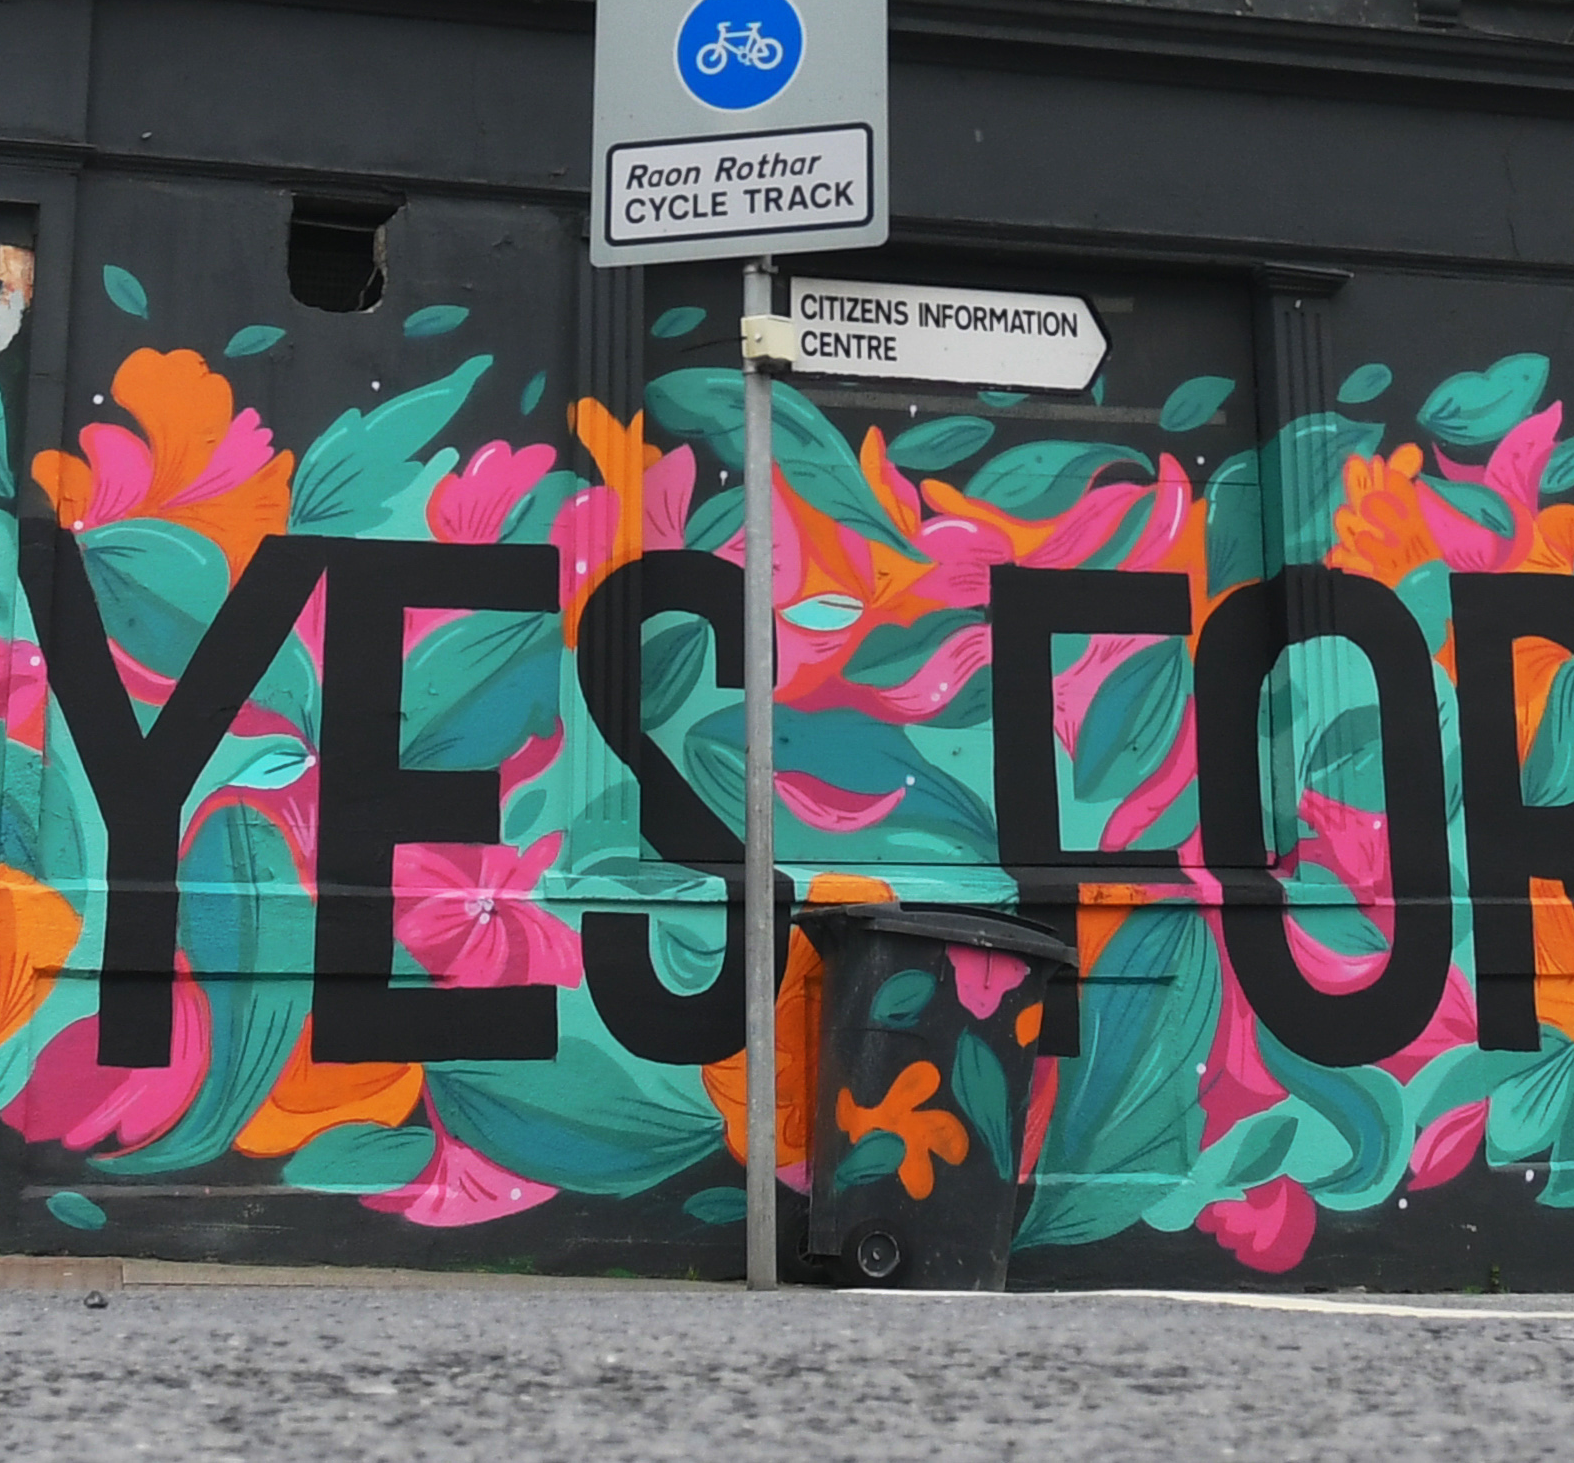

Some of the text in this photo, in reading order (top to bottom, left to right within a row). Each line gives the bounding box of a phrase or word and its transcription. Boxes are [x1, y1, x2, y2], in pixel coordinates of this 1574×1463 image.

[625, 152, 823, 190] Raon Rothar
[624, 180, 855, 225] CYCLE TRACK
[800, 293, 1079, 338] CITIZENS INFORMATION
[800, 330, 898, 361] CENTRE
[18, 516, 793, 1068] YES
